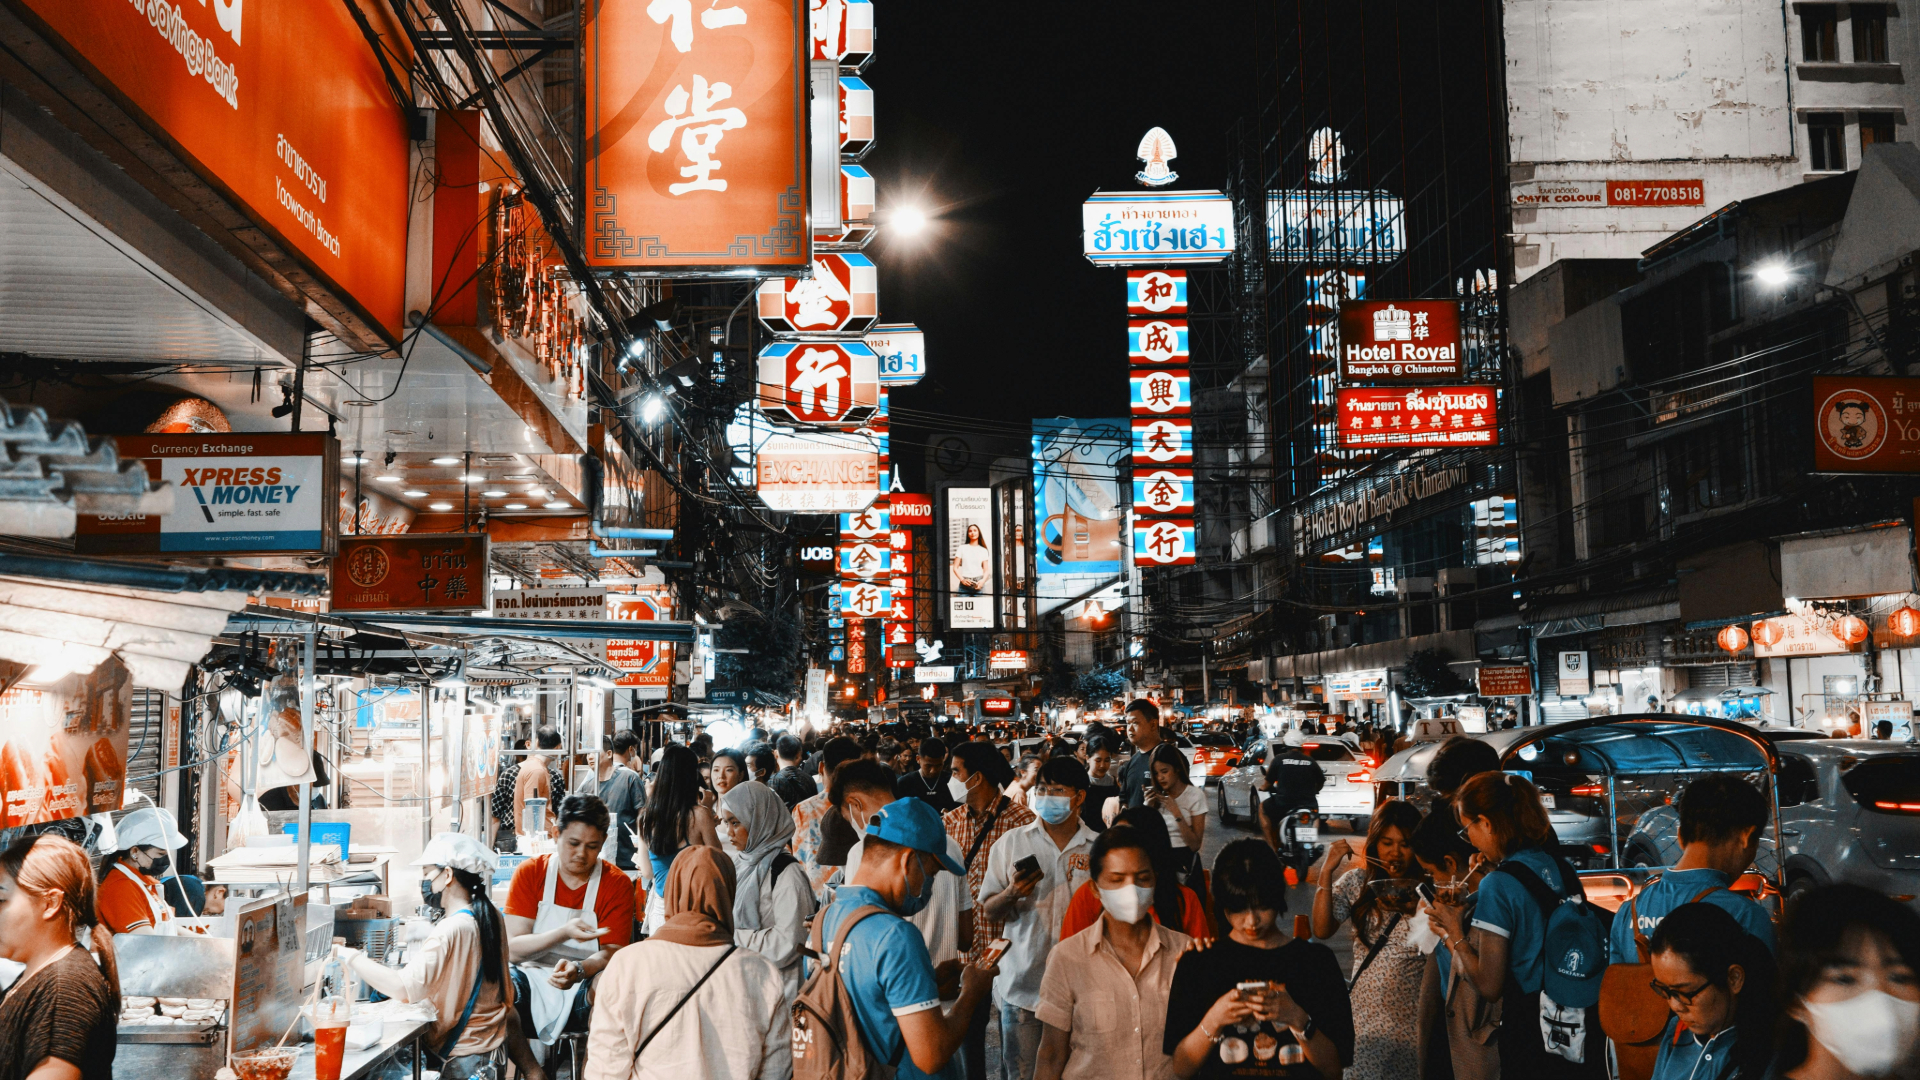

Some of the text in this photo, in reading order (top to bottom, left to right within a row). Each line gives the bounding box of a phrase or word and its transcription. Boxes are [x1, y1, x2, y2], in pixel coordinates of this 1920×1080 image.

[204, 38, 239, 110] Bank
[276, 133, 327, 204] สาขาเยาวราช
[1516, 194, 1602, 203] CMYK COLOUR
[1614, 186, 1701, 201] 081-7708518
[275, 175, 340, 259] Yaowarath Branch
[1121, 206, 1198, 220] ห้างขายทอง
[1346, 342, 1456, 361] Hotel Royal
[1347, 364, 1390, 376] Bangkok
[1405, 363, 1456, 374] Chinatown
[1346, 398, 1401, 412] ร้านขายยา
[1143, 276, 1180, 558] 和成興大金行
[1346, 434, 1361, 444] LIM
[1411, 432, 1449, 443] NATURAL
[1450, 431, 1491, 442] MEDICINE
[151, 443, 254, 455] Currency Exchange
[180, 467, 282, 487] XPRESS
[759, 460, 877, 484] EXCHANGE
[210, 485, 300, 504] MONEY
[1311, 502, 1337, 541] Hotel
[1339, 488, 1369, 534] Royal
[1370, 474, 1410, 522] Bangkok
[1413, 461, 1468, 500] Chinatown
[265, 508, 281, 517] safe
[421, 548, 468, 570] ยาจีน
[800, 546, 834, 561] UOB
[291, 599, 320, 608] Fruit
[742, 691, 749, 700] 9
[1557, 967, 1586, 978] SOKFARM
